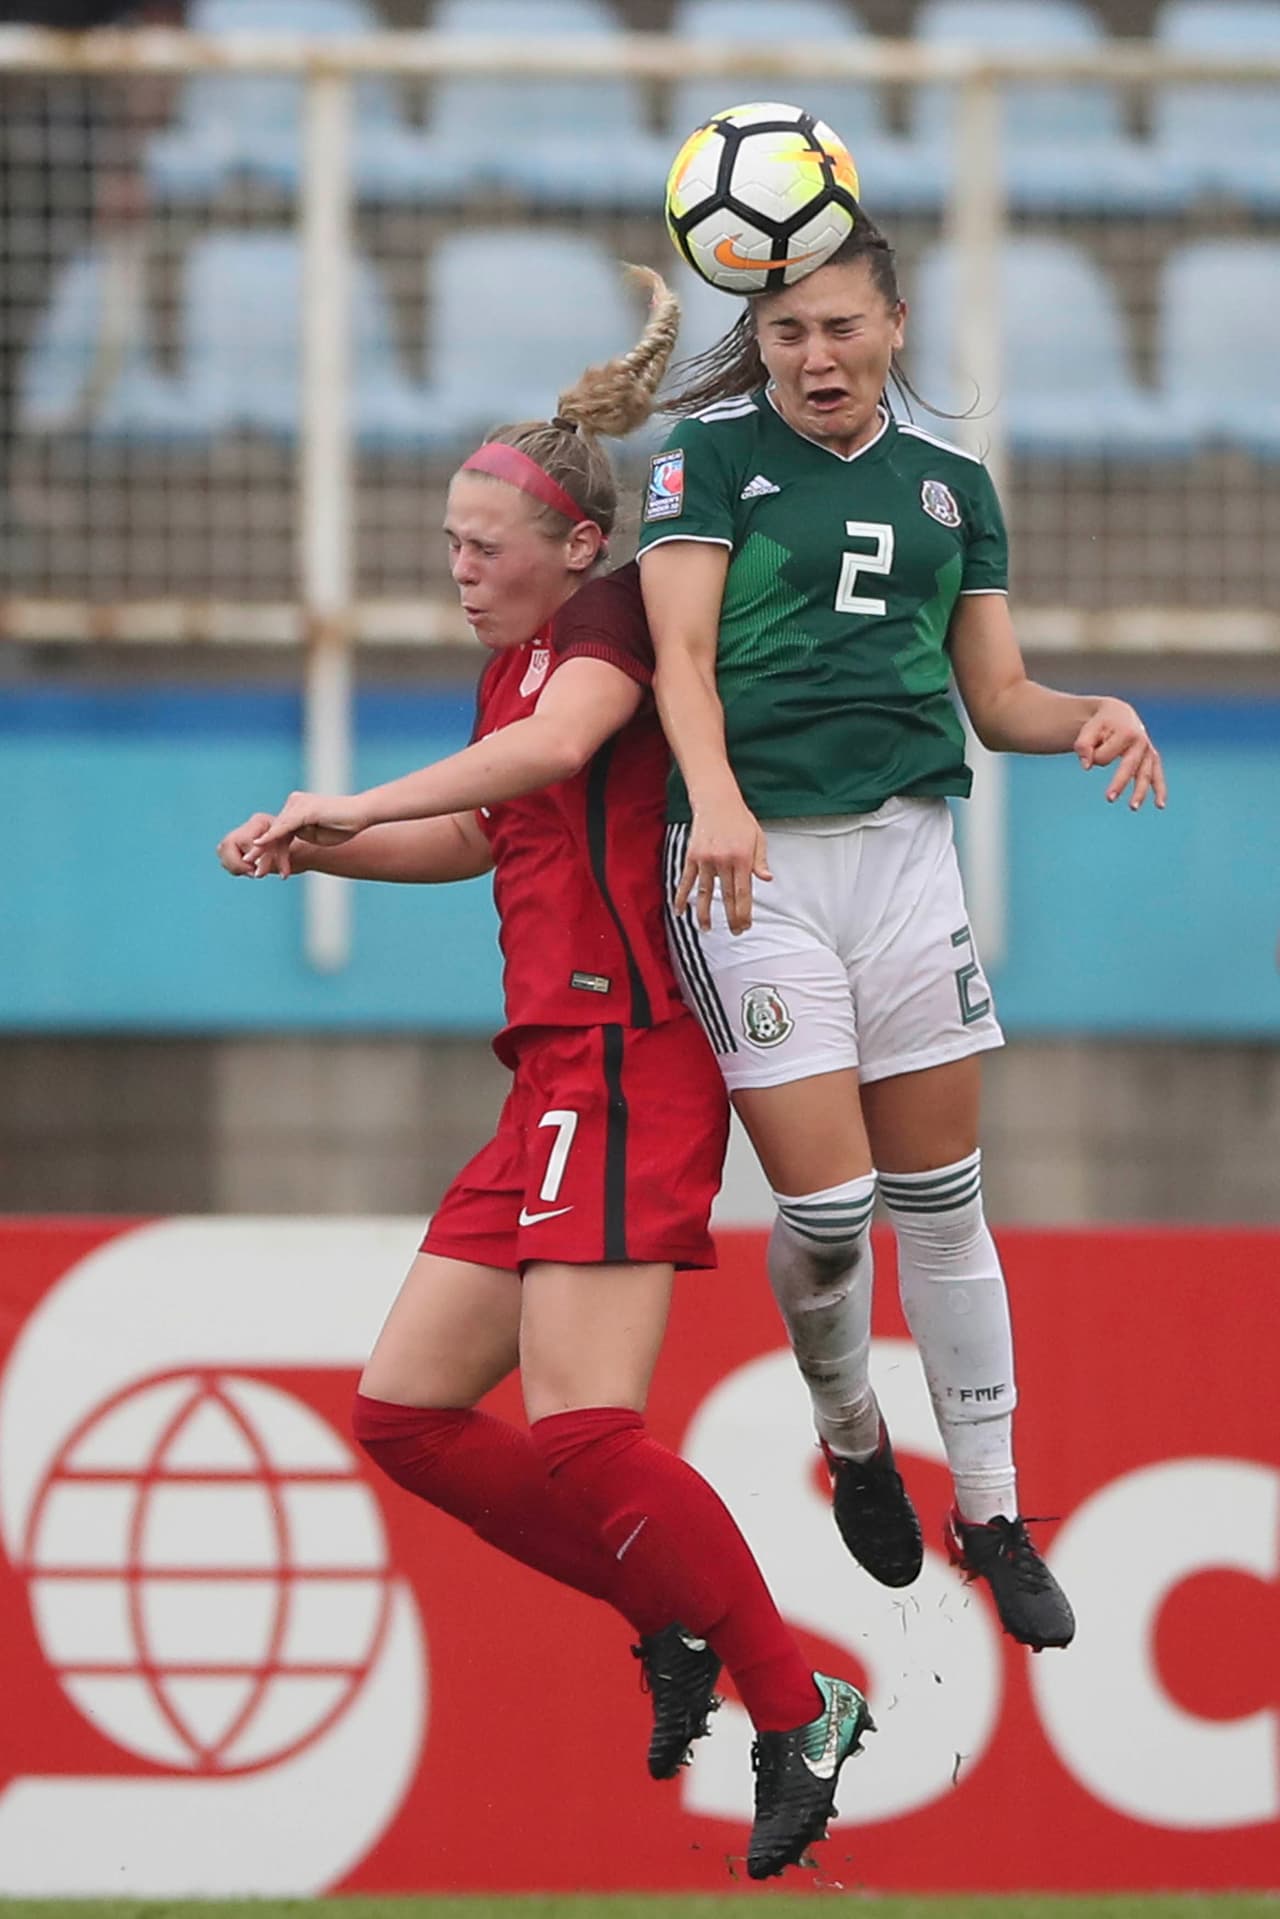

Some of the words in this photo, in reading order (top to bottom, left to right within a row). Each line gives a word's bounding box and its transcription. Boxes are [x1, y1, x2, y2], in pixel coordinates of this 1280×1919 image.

[740, 485, 781, 500] adidas
[834, 520, 894, 617] 2
[950, 923, 990, 1026] 2
[538, 1110, 579, 1201] 7
[960, 1383, 1005, 1402] FMF
